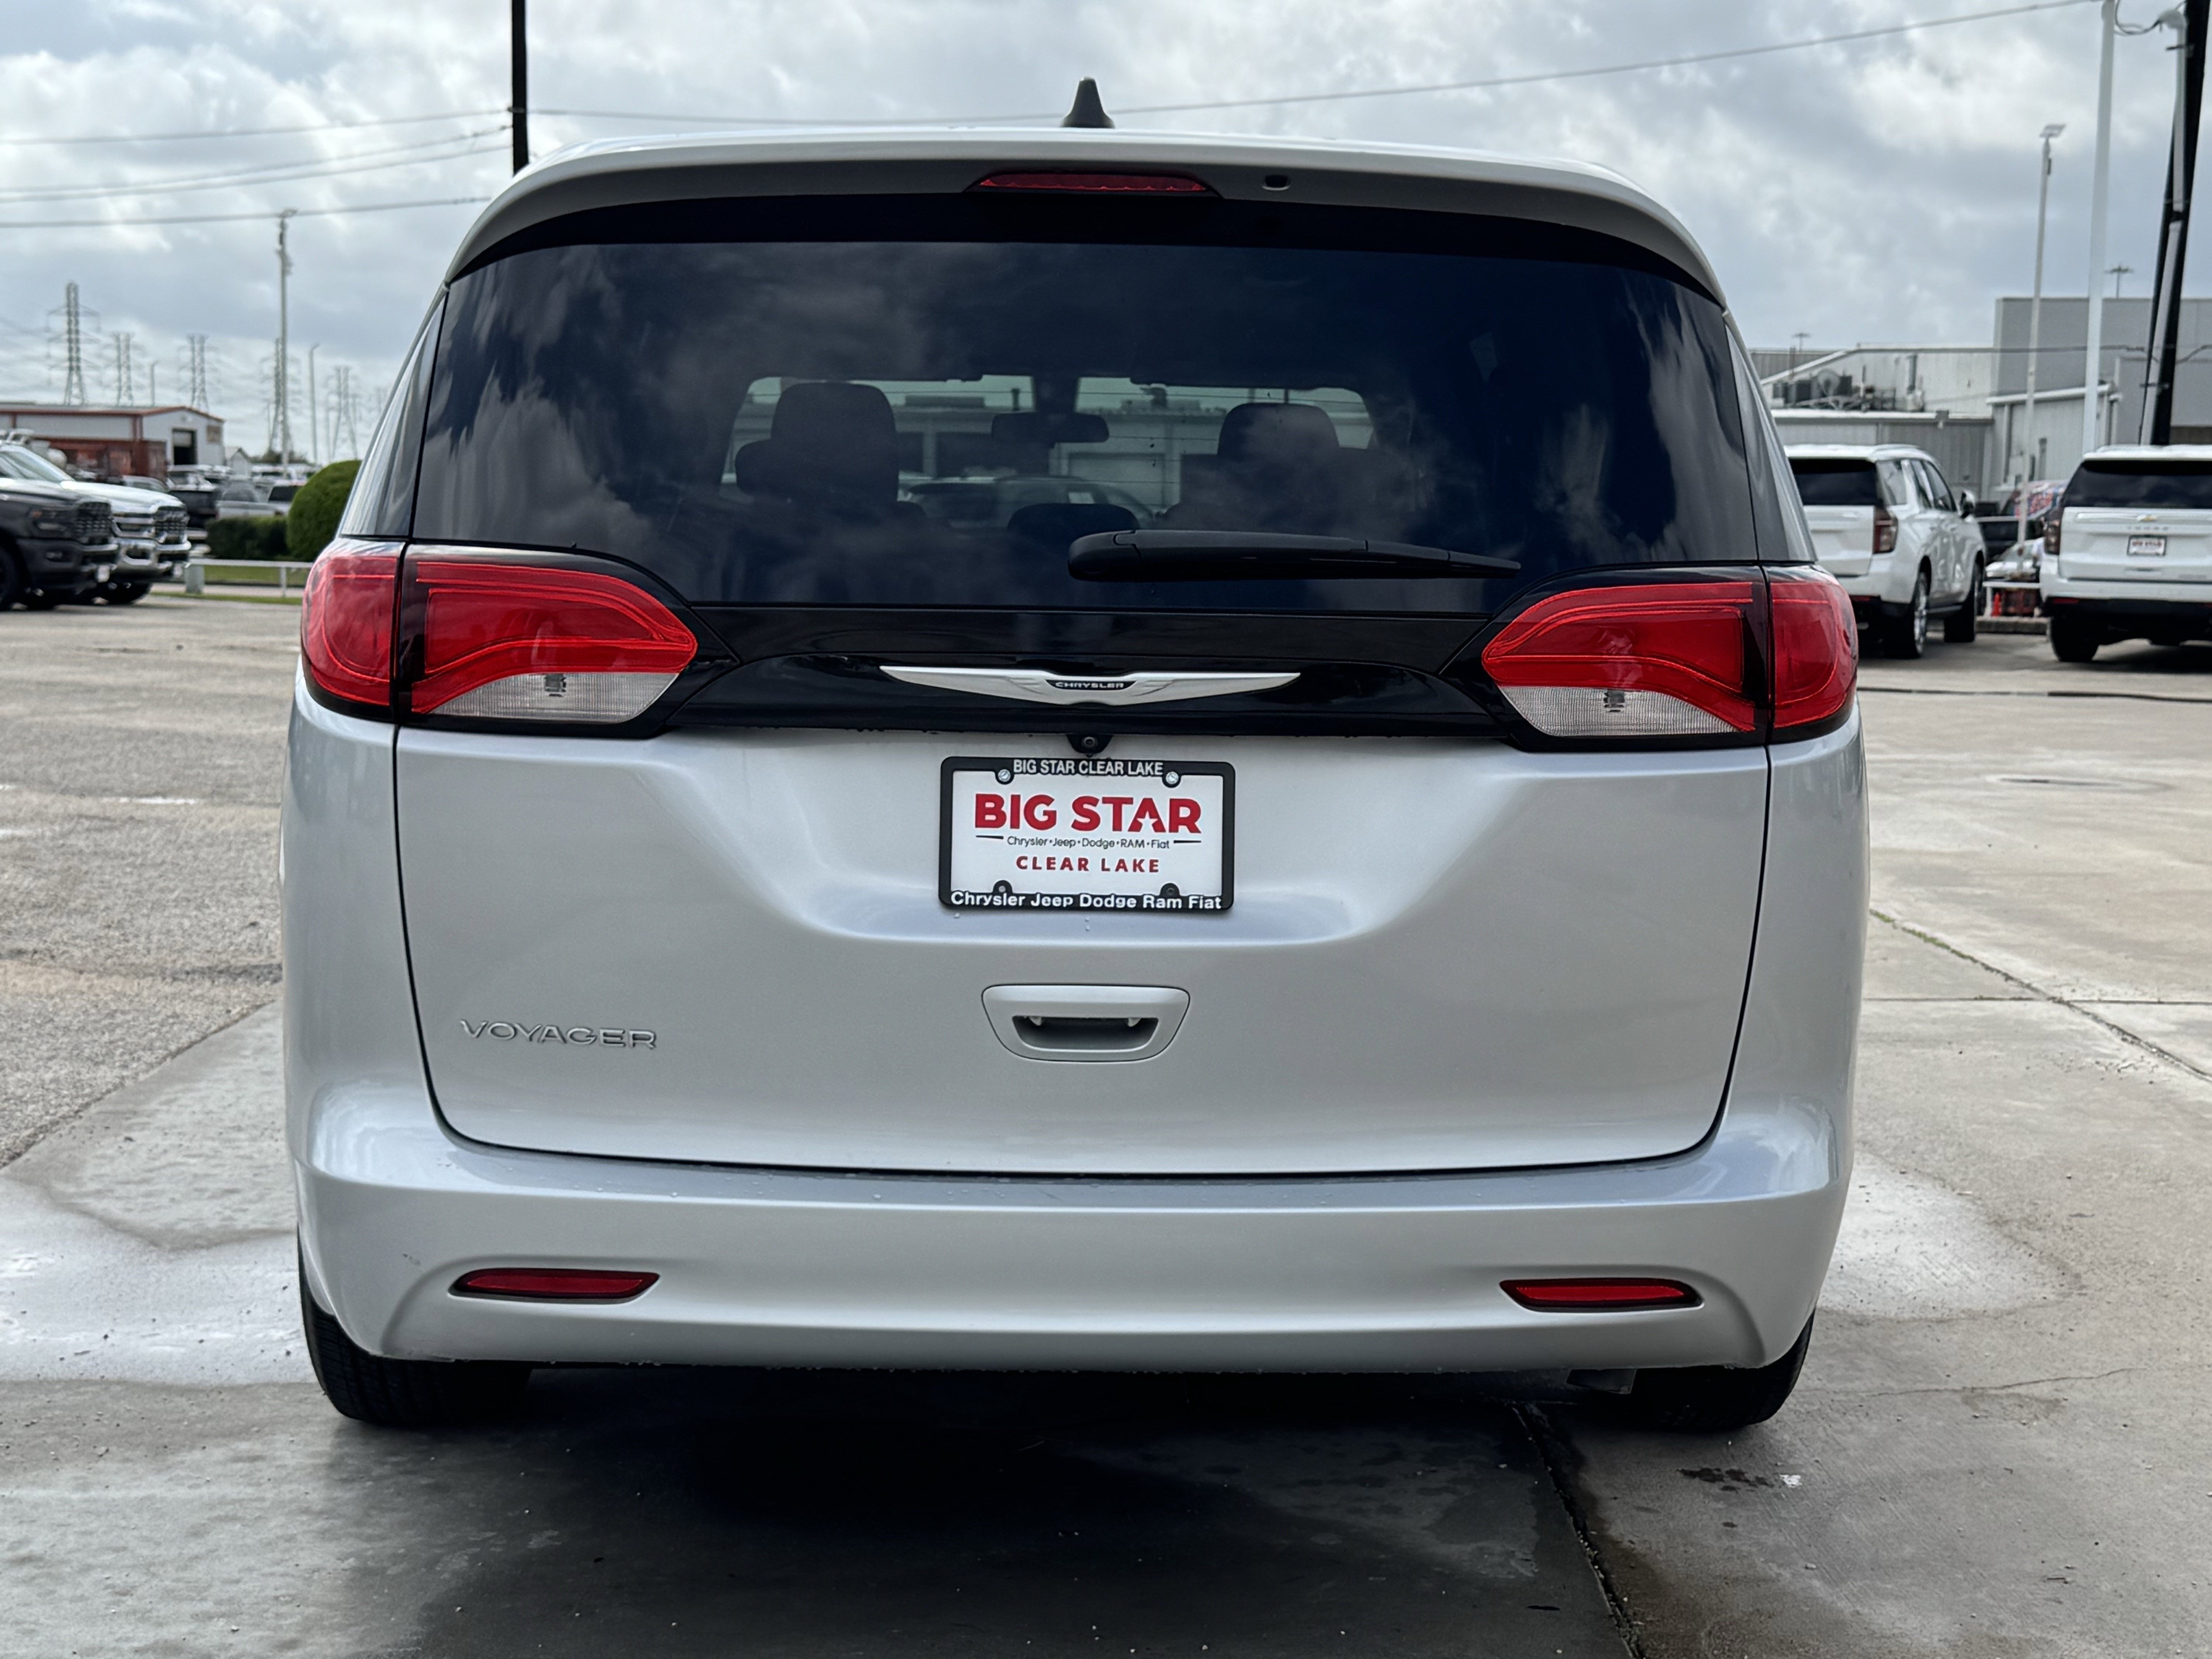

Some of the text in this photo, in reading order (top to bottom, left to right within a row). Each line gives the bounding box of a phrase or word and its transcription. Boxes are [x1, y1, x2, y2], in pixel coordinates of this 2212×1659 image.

[1013, 759, 1163, 775] BIG STAR CLEAR LAKE
[975, 793, 1201, 833] BIG STAR
[1016, 856, 1159, 872] CLEAR LAKE
[951, 891, 1221, 909] Chrysler Jeep Dodge Ram Fiat
[460, 1019, 657, 1050] VOYAGER
